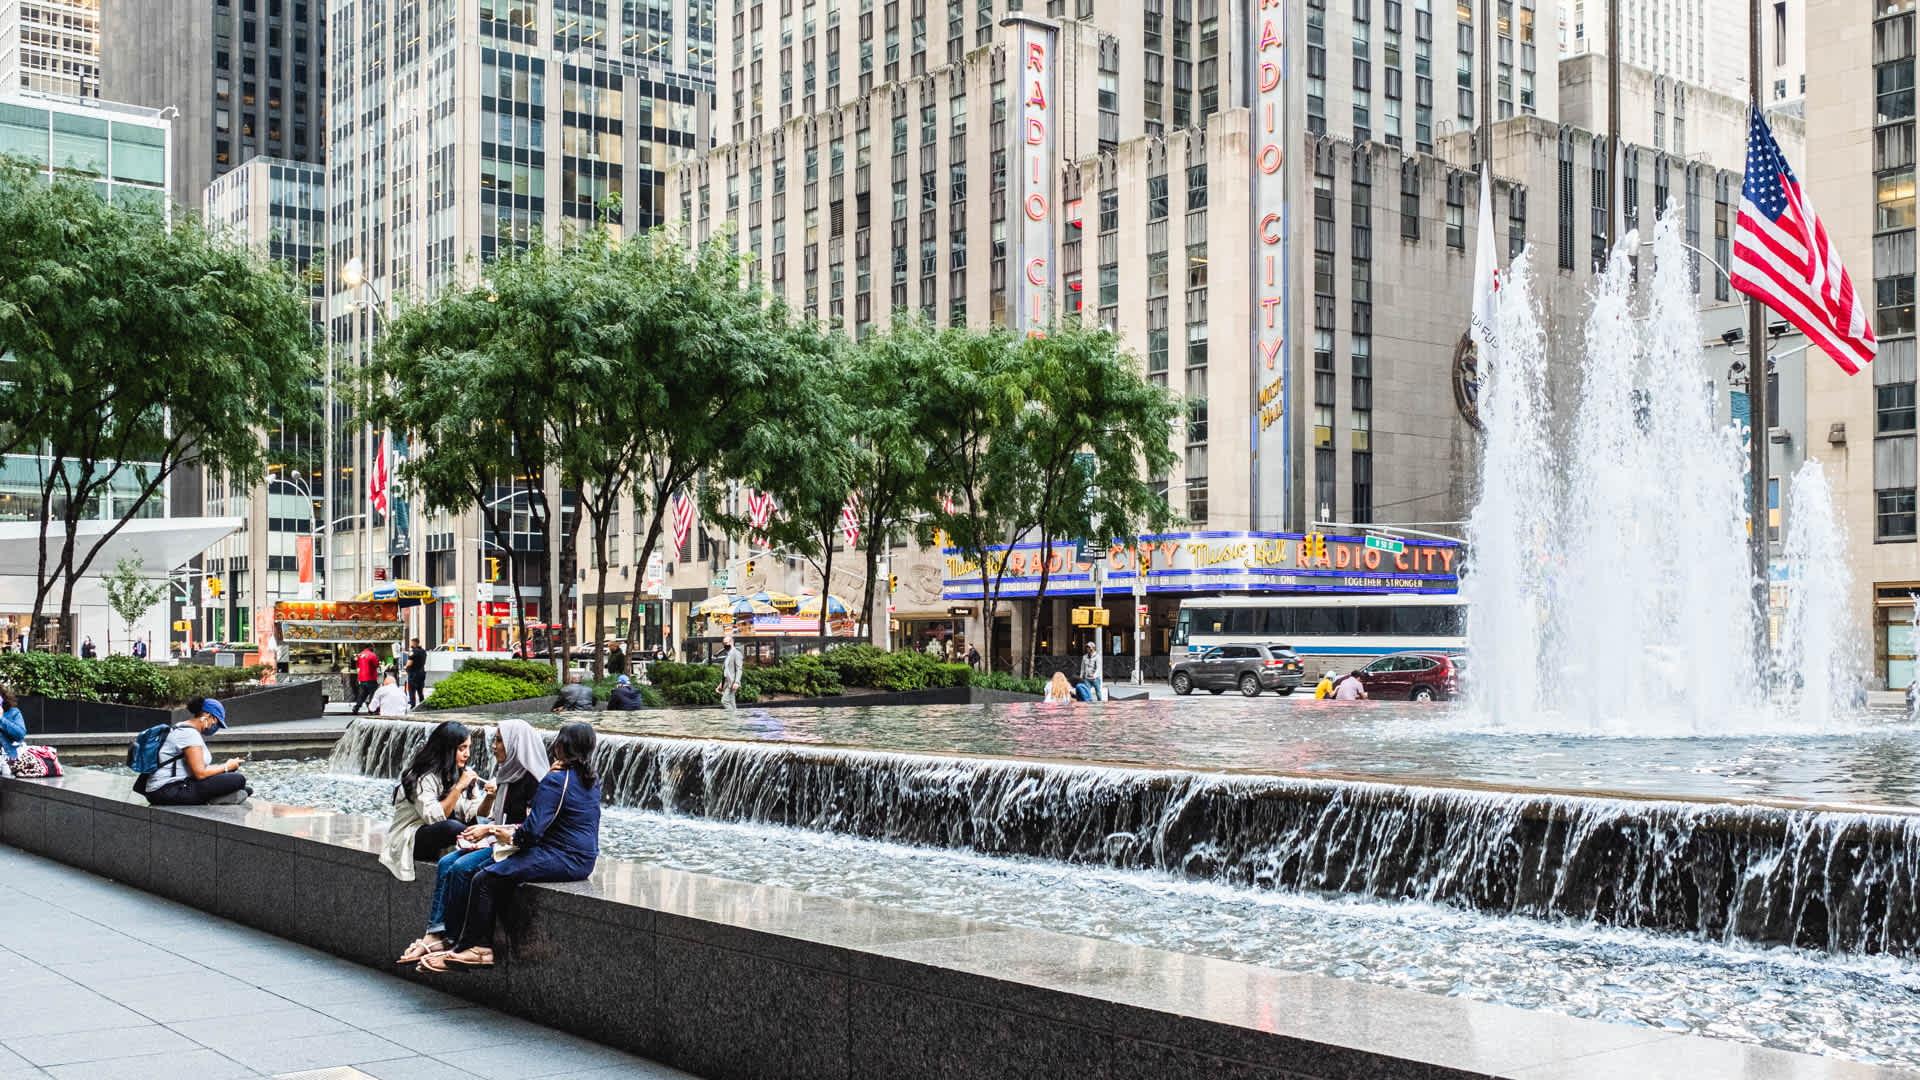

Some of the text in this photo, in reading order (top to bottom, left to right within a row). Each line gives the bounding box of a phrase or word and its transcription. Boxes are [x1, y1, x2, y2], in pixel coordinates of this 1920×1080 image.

[1025, 41, 1048, 222] RADIO
[1258, 0, 1283, 370] ADIO CITY
[1109, 541, 1179, 570] CITY
[1187, 538, 1287, 569] Music Hall
[1394, 546, 1454, 571] CITY
[1280, 575, 1297, 585] ONE
[1344, 576, 1423, 588] TOGETHER STRONGER
